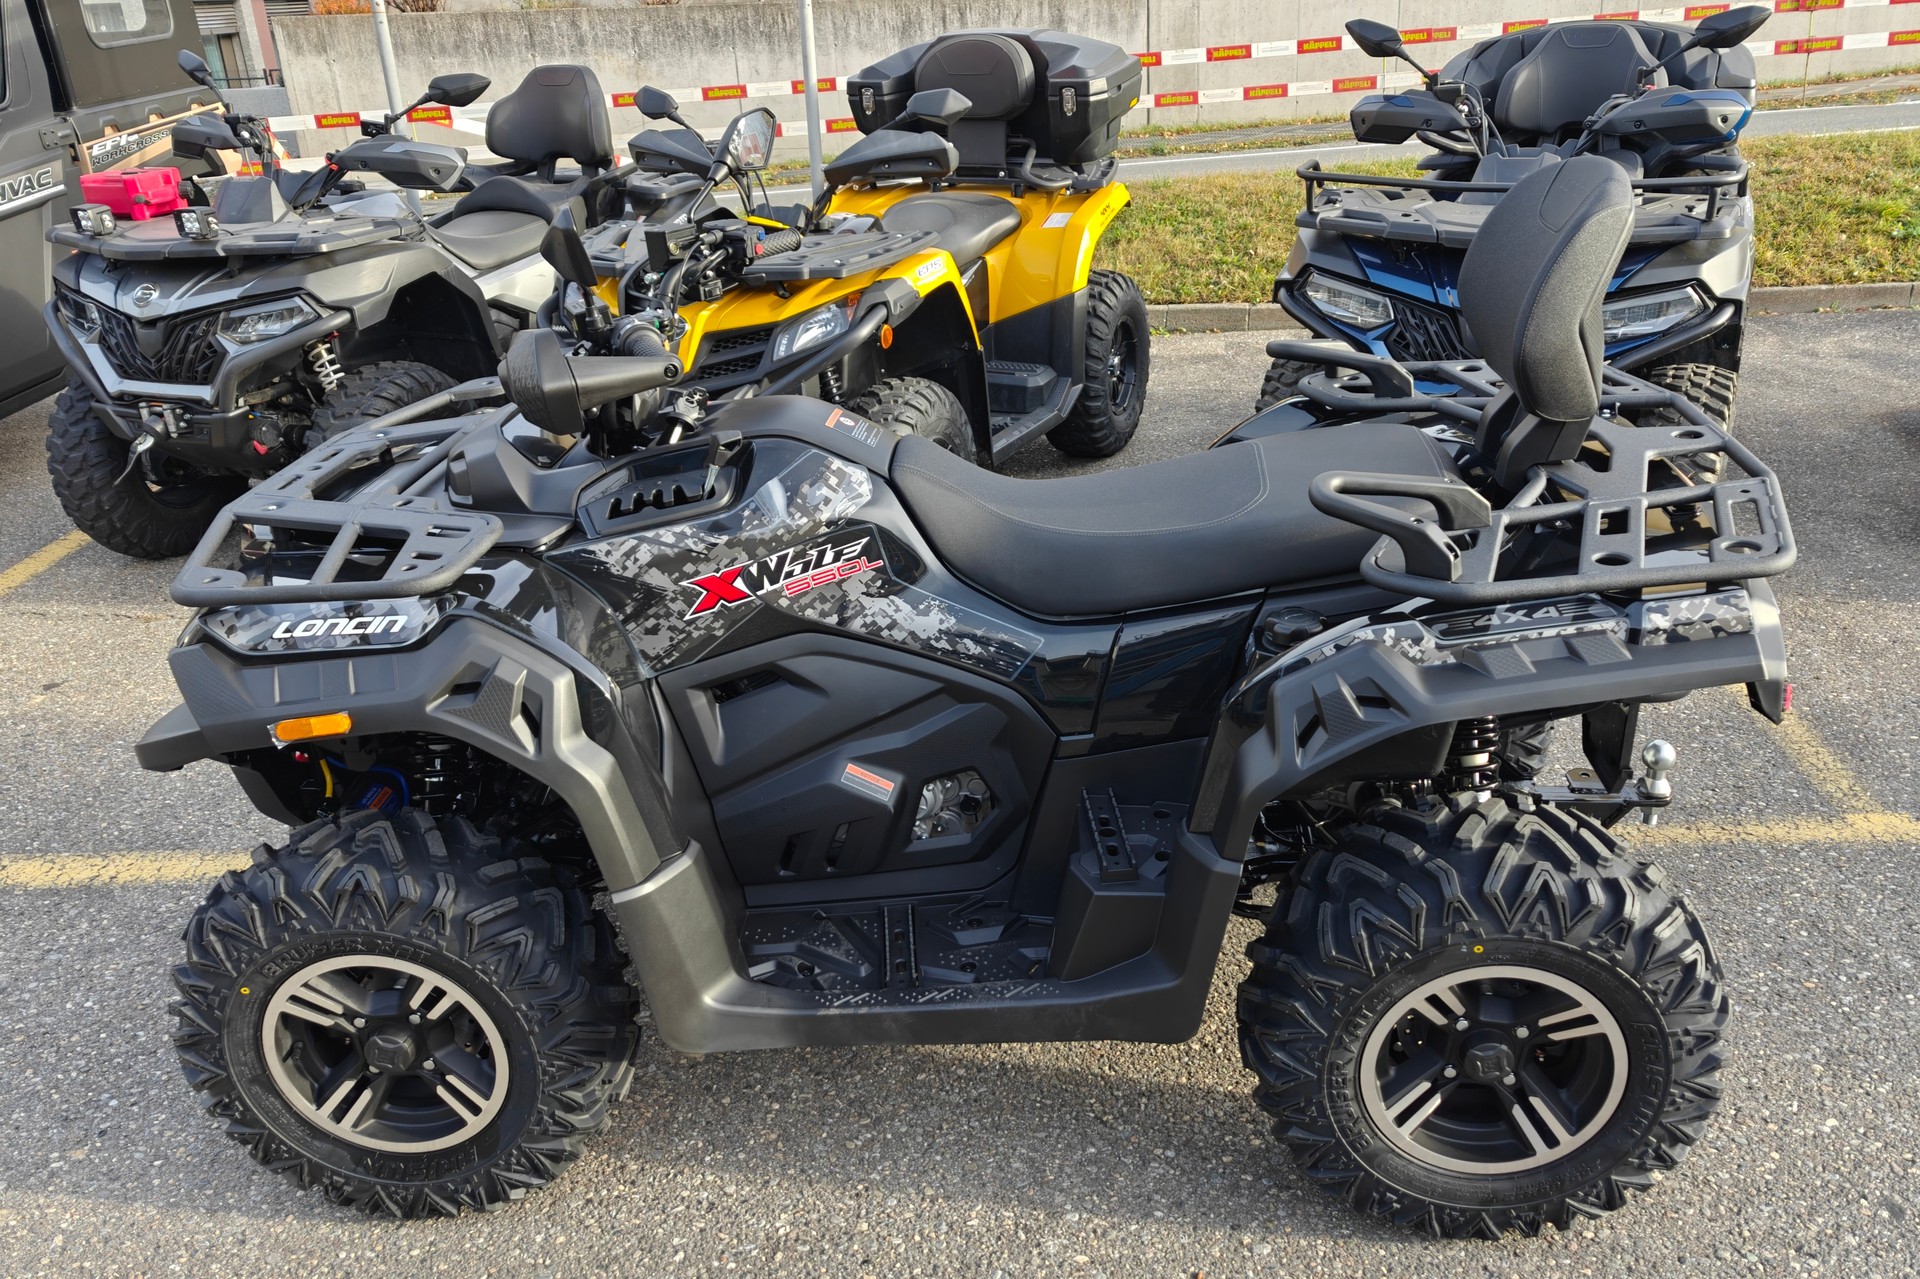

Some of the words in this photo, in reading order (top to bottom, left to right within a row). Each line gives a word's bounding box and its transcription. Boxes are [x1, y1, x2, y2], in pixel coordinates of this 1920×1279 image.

[1303, 41, 1336, 50] KÄPPELI
[1213, 48, 1246, 58] KÄPPELI
[1338, 80, 1371, 89] KÄPPELI
[708, 88, 741, 97] KÄPPELI
[1249, 87, 1282, 97] KÄPPELI
[1161, 95, 1193, 104] KÄPPELI
[412, 110, 445, 119] KÄPPELI
[321, 115, 354, 125] KÄPPELI
[92, 130, 170, 168] WORKCROSS
[783, 557, 883, 598] 550L
[271, 615, 408, 639] LONCIN
